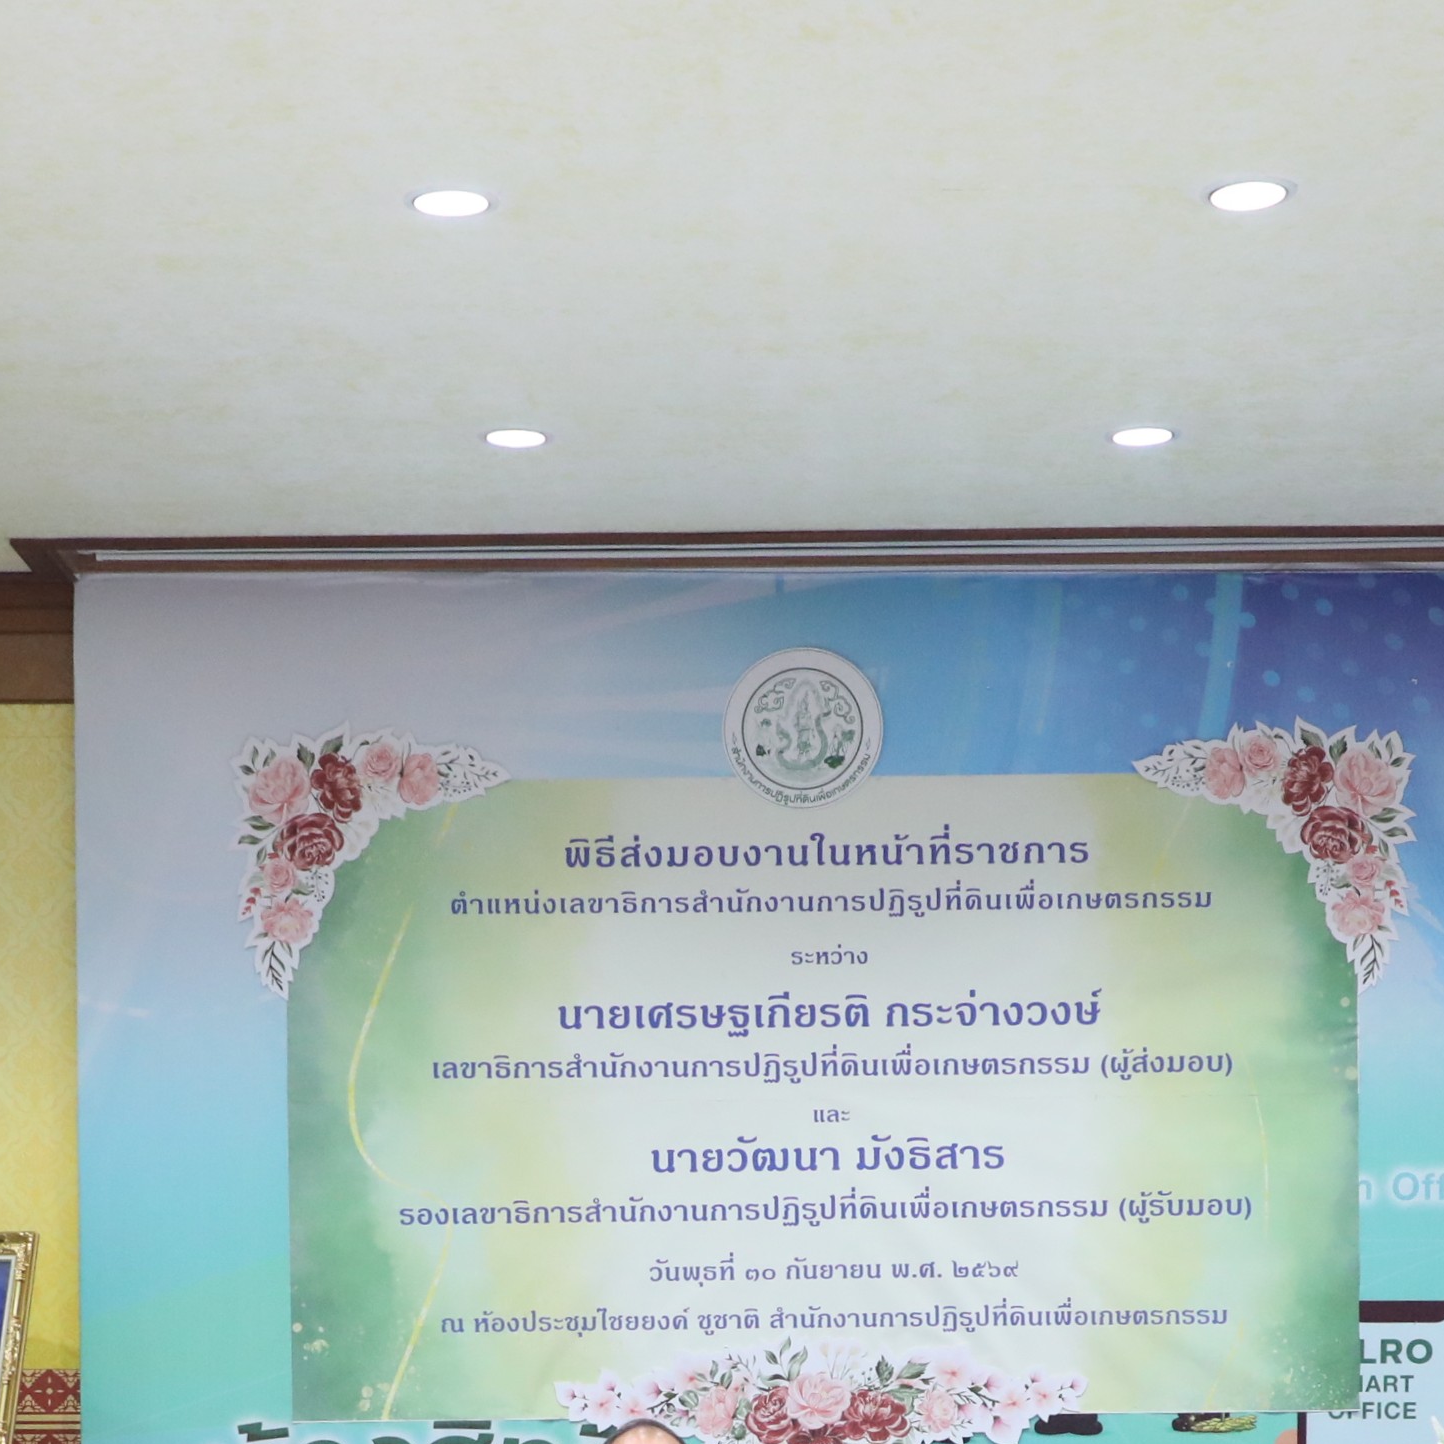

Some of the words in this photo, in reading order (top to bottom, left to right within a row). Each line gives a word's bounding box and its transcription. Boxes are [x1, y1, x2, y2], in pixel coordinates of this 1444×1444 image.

[564, 823, 1089, 869] พิธีส่งมอบงานในหน้าที่ราชการ
[450, 878, 1212, 918] ตำแหน่งเลขาธิการสำนักงานการปฏิรูปที่ดินเพื่อเกษตรกรรม
[790, 943, 869, 966] ระหว่าง
[557, 990, 871, 1038] นายเศรษฐเกียรติ
[885, 987, 1103, 1028] กระจ่างวงษ์
[432, 1042, 1091, 1085] เลขาธิการสำนักงานการปฏิรูปที่ดินเพื่อเกษตรกรรม
[1100, 1046, 1233, 1081] (ผู้ส่งมอบ)
[813, 1108, 851, 1124] และ
[650, 1135, 841, 1174] นายวัฒนา
[855, 1133, 1005, 1171] มังธิสาร
[398, 1185, 1109, 1228] รองเลขาธิการสำนักงานการปฏิรูปที่ดินเพื่อเกษตรกรรม
[1118, 1189, 1252, 1225] (ผู้รับมอบ)
[648, 1251, 736, 1288] วันพุธที่
[744, 1268, 777, 1282] ๓๐
[785, 1256, 882, 1281] กันยายน
[890, 1260, 943, 1279] พ.ศ.
[951, 1259, 1019, 1279] ๒๕๖๙
[441, 1317, 465, 1334] ณ
[473, 1306, 691, 1338] ห้องประชุมไชยยงค์
[696, 1307, 761, 1337] ชูชาติ
[769, 1296, 1228, 1334] สำนักงานการปฏิรูปที่ดินเพื่อเกษตรกรรม
[1359, 1338, 1433, 1364] LRO
[1359, 1374, 1414, 1393] ART
